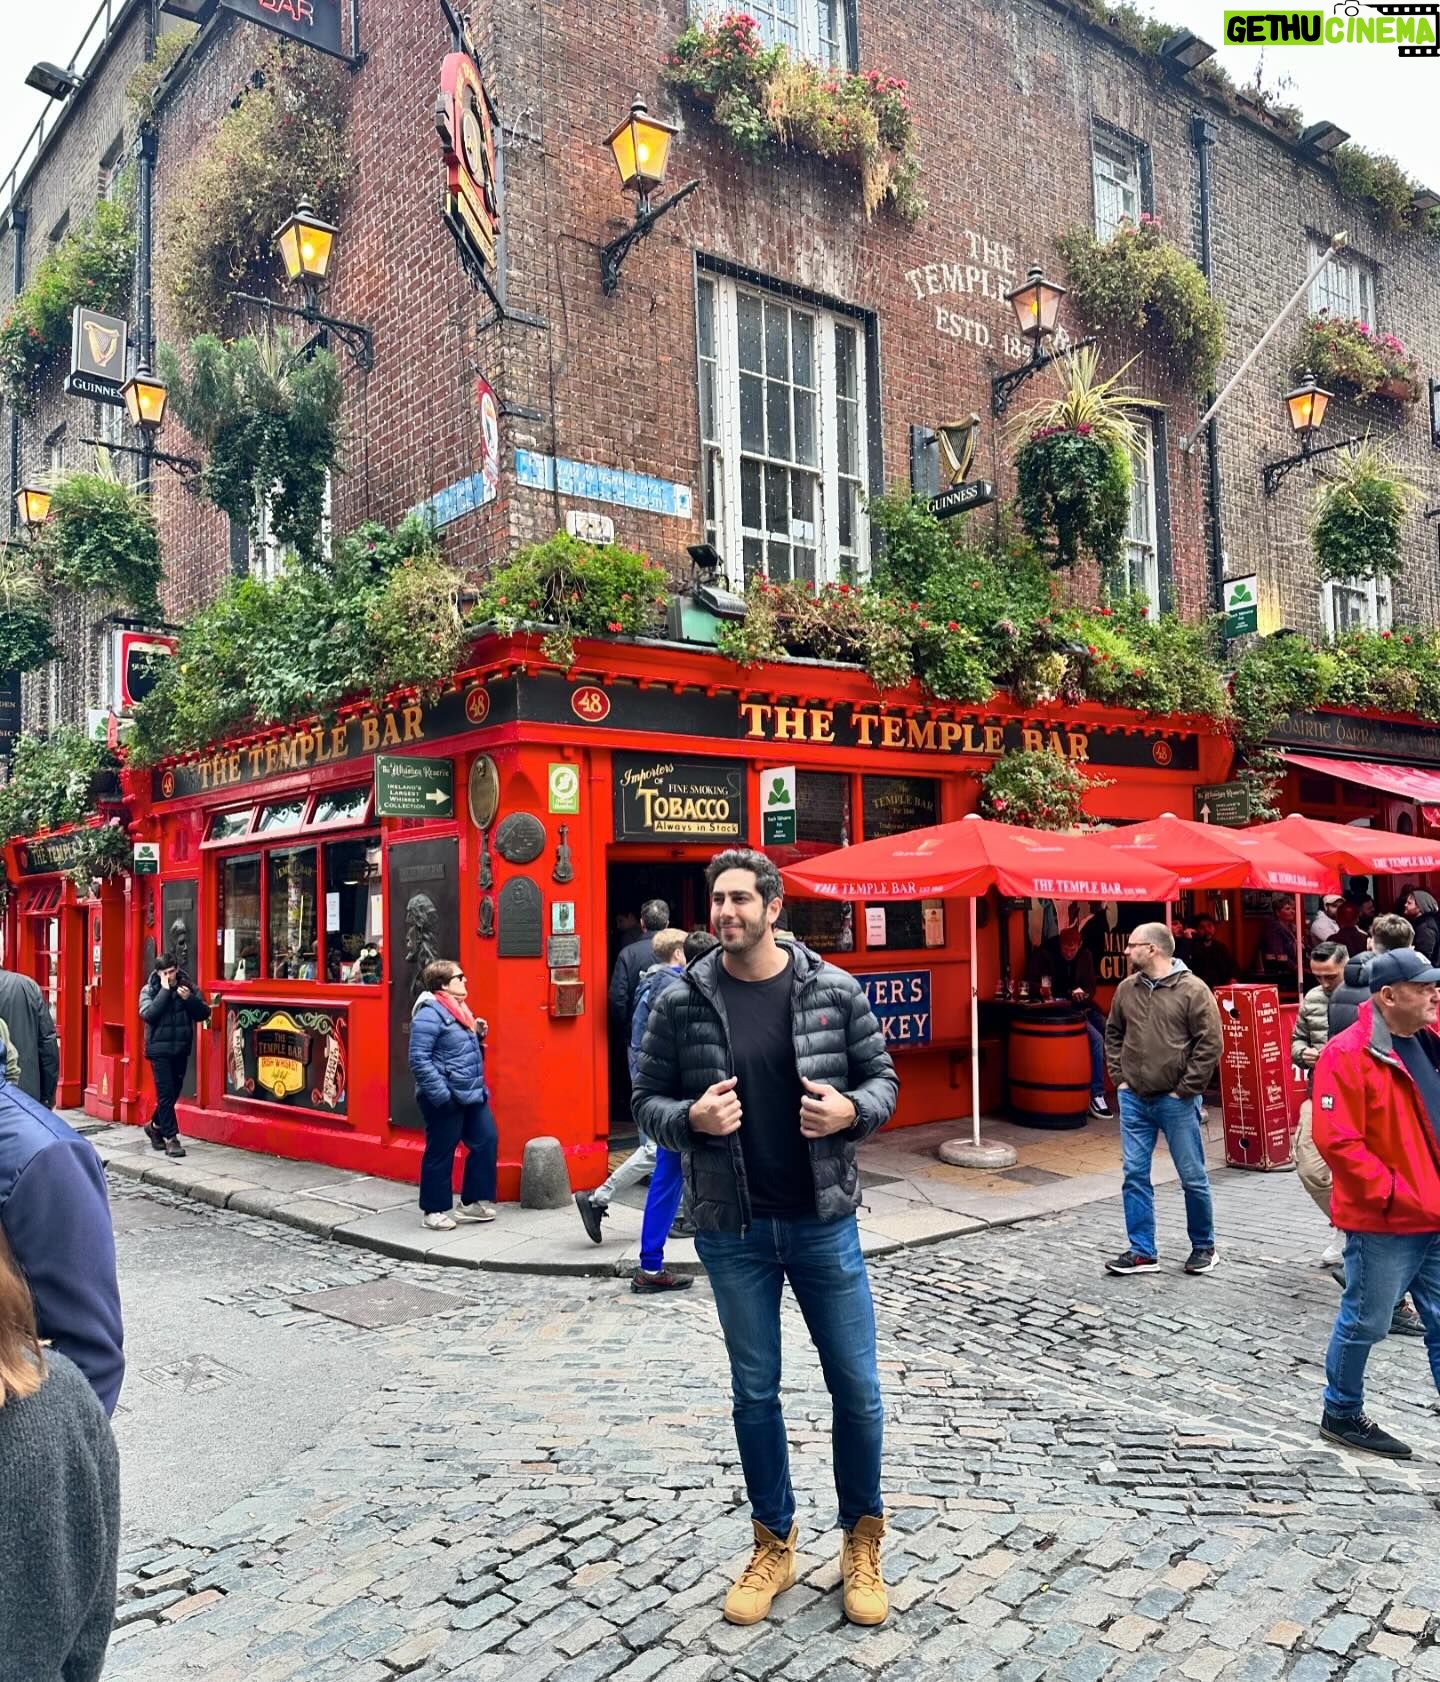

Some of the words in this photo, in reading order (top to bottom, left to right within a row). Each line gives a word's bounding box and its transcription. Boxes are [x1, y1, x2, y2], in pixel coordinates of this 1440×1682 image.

[965, 229, 1016, 275] THE
[927, 485, 978, 513] GUINNESS
[470, 695, 485, 718] 48
[578, 691, 602, 713] 48
[741, 703, 836, 741] THE
[852, 713, 1005, 754] TEMPLE
[1022, 728, 1089, 760] BAR
[199, 754, 240, 789] THE
[248, 726, 348, 774] TEMPLE
[362, 705, 425, 750] BAR
[620, 762, 674, 787] Importers
[668, 784, 688, 794] FINE
[690, 785, 728, 795] SMOKING
[635, 788, 729, 827] TOBACCO
[656, 821, 691, 832] Always
[697, 824, 706, 832] in
[709, 822, 737, 832] Stock
[813, 883, 838, 895] THE
[842, 882, 889, 895] TEMPLE
[892, 882, 916, 894] BAR
[1032, 878, 1054, 892] THE
[1056, 880, 1098, 895] TEMPLE
[1101, 881, 1123, 895] BAR
[258, 1042, 286, 1055] TEMPLE
[288, 1045, 303, 1060] BAR
